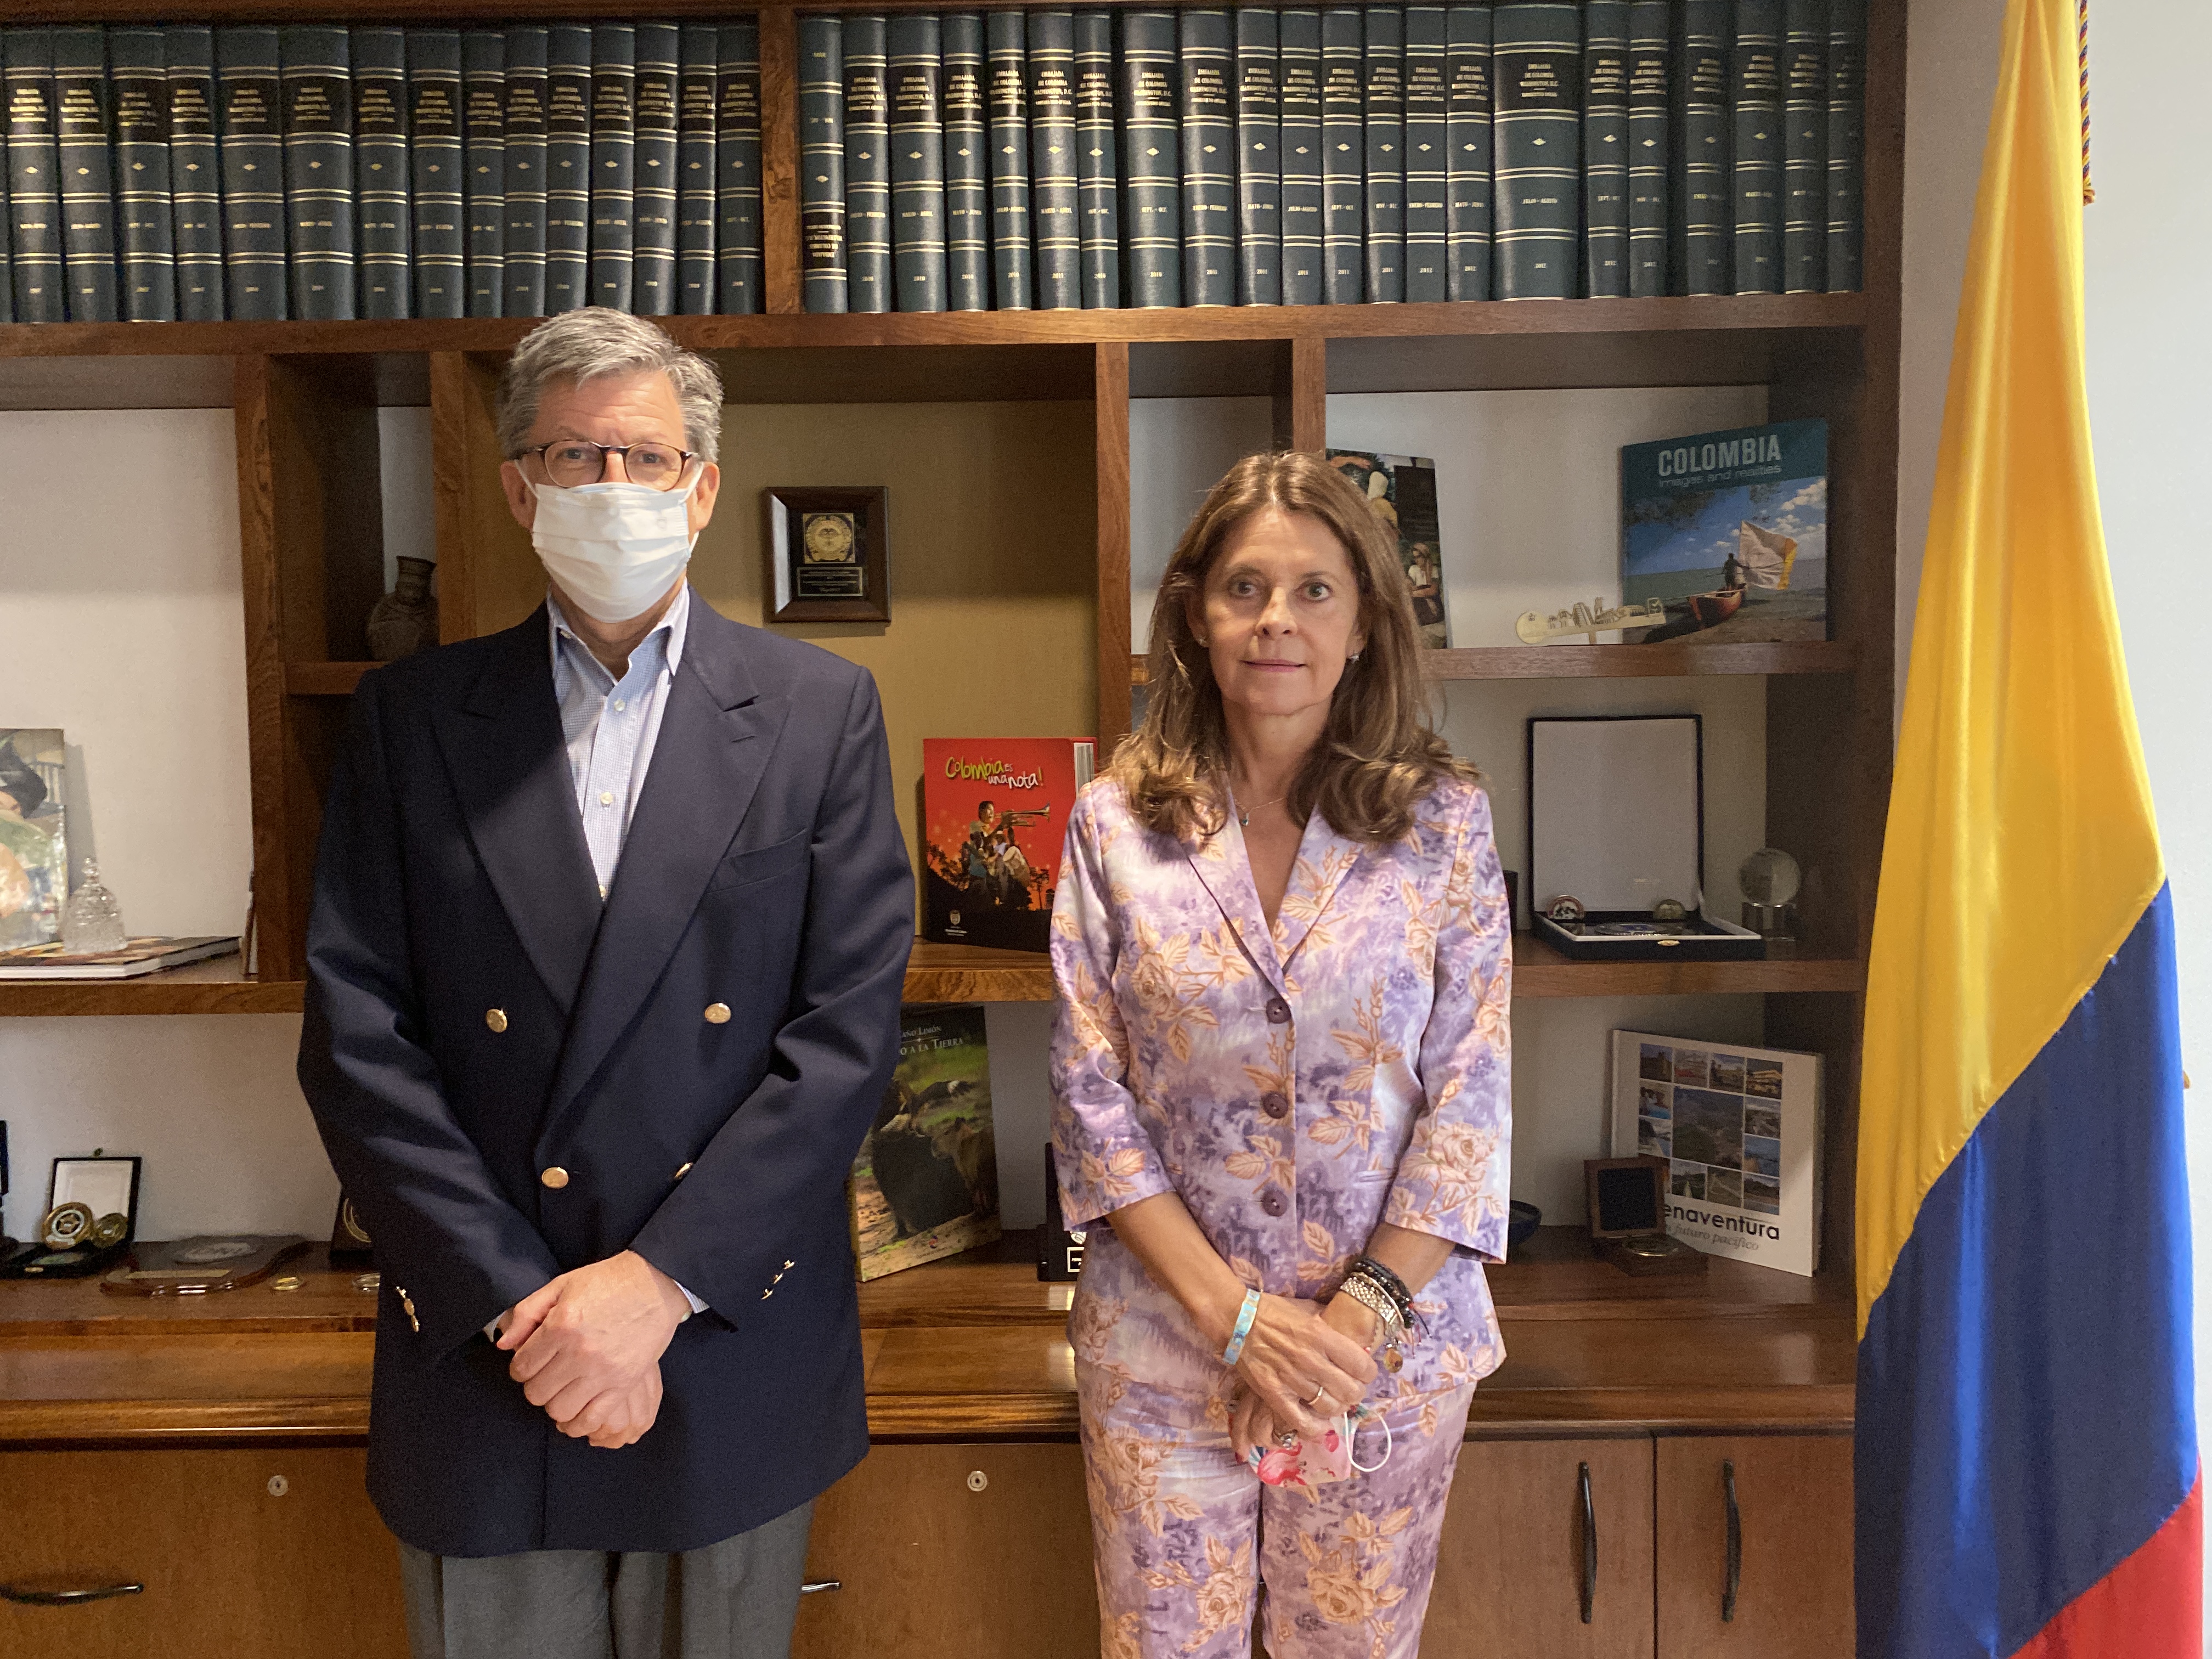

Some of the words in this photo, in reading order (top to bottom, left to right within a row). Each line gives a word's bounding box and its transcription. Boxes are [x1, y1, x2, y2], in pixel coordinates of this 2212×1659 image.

[1658, 435, 1781, 476] COLOMBIA
[1707, 469, 1732, 482] and
[1735, 465, 1782, 478] realities
[945, 755, 1005, 780] Colombia
[988, 774, 1008, 785] una
[1008, 766, 1043, 789] nota!
[900, 1047, 907, 1056] O
[1664, 1203, 1780, 1240] enaventura
[1673, 1223, 1711, 1240] futuro
